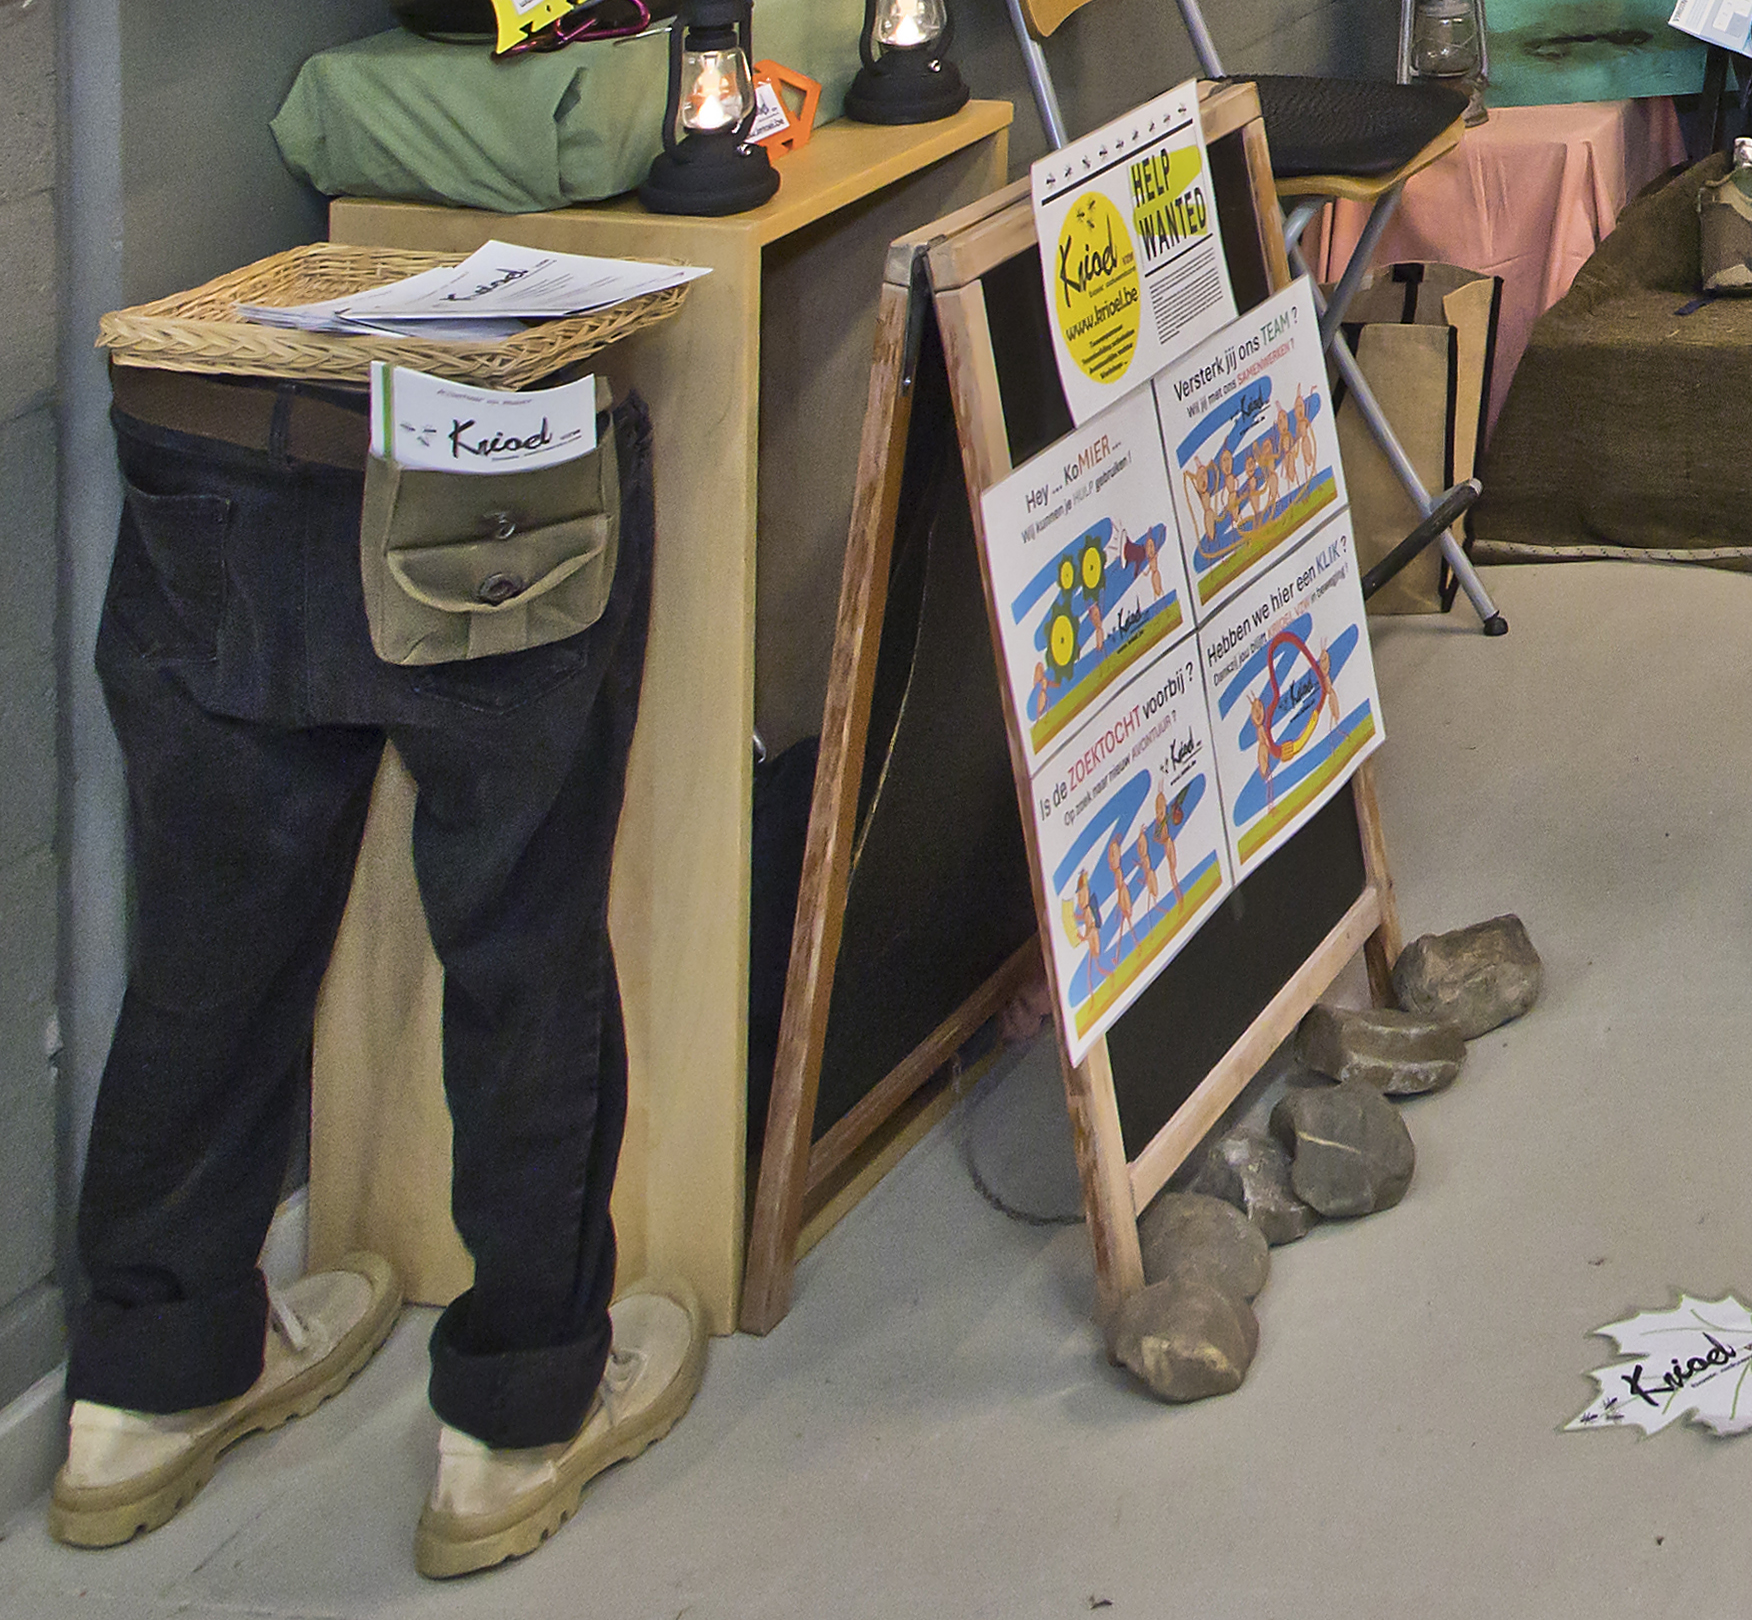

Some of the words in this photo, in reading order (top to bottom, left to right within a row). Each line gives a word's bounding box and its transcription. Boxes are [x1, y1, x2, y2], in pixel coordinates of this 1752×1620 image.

[1131, 148, 1170, 209] HELP
[1059, 212, 1118, 308] Krioel
[1139, 186, 1206, 262] WANTED
[1066, 287, 1139, 341] www.krioel.be
[1173, 357, 1225, 401] Versterk
[1224, 346, 1237, 375] jij
[1238, 336, 1260, 361] ons
[1260, 311, 1290, 345] TEAM
[1292, 306, 1298, 324] ?
[1208, 389, 1222, 405] met
[1237, 343, 1290, 385] SAMENWERKEN
[1025, 484, 1049, 513] Hey
[1063, 434, 1111, 485] KoMIER
[1206, 618, 1252, 668] Hebben
[1251, 603, 1270, 627] we
[1270, 582, 1295, 612] hier
[1296, 566, 1316, 592] een
[1315, 540, 1340, 574] KLIK
[1341, 535, 1347, 553] ?
[1039, 796, 1051, 821] Is
[1052, 779, 1067, 808] de
[1067, 705, 1141, 791] ZOEKTOCHT
[1142, 668, 1186, 719] voorbij
[1186, 661, 1193, 681] ?
[1064, 809, 1075, 826] Op
[1621, 1331, 1737, 1407] Krioel
